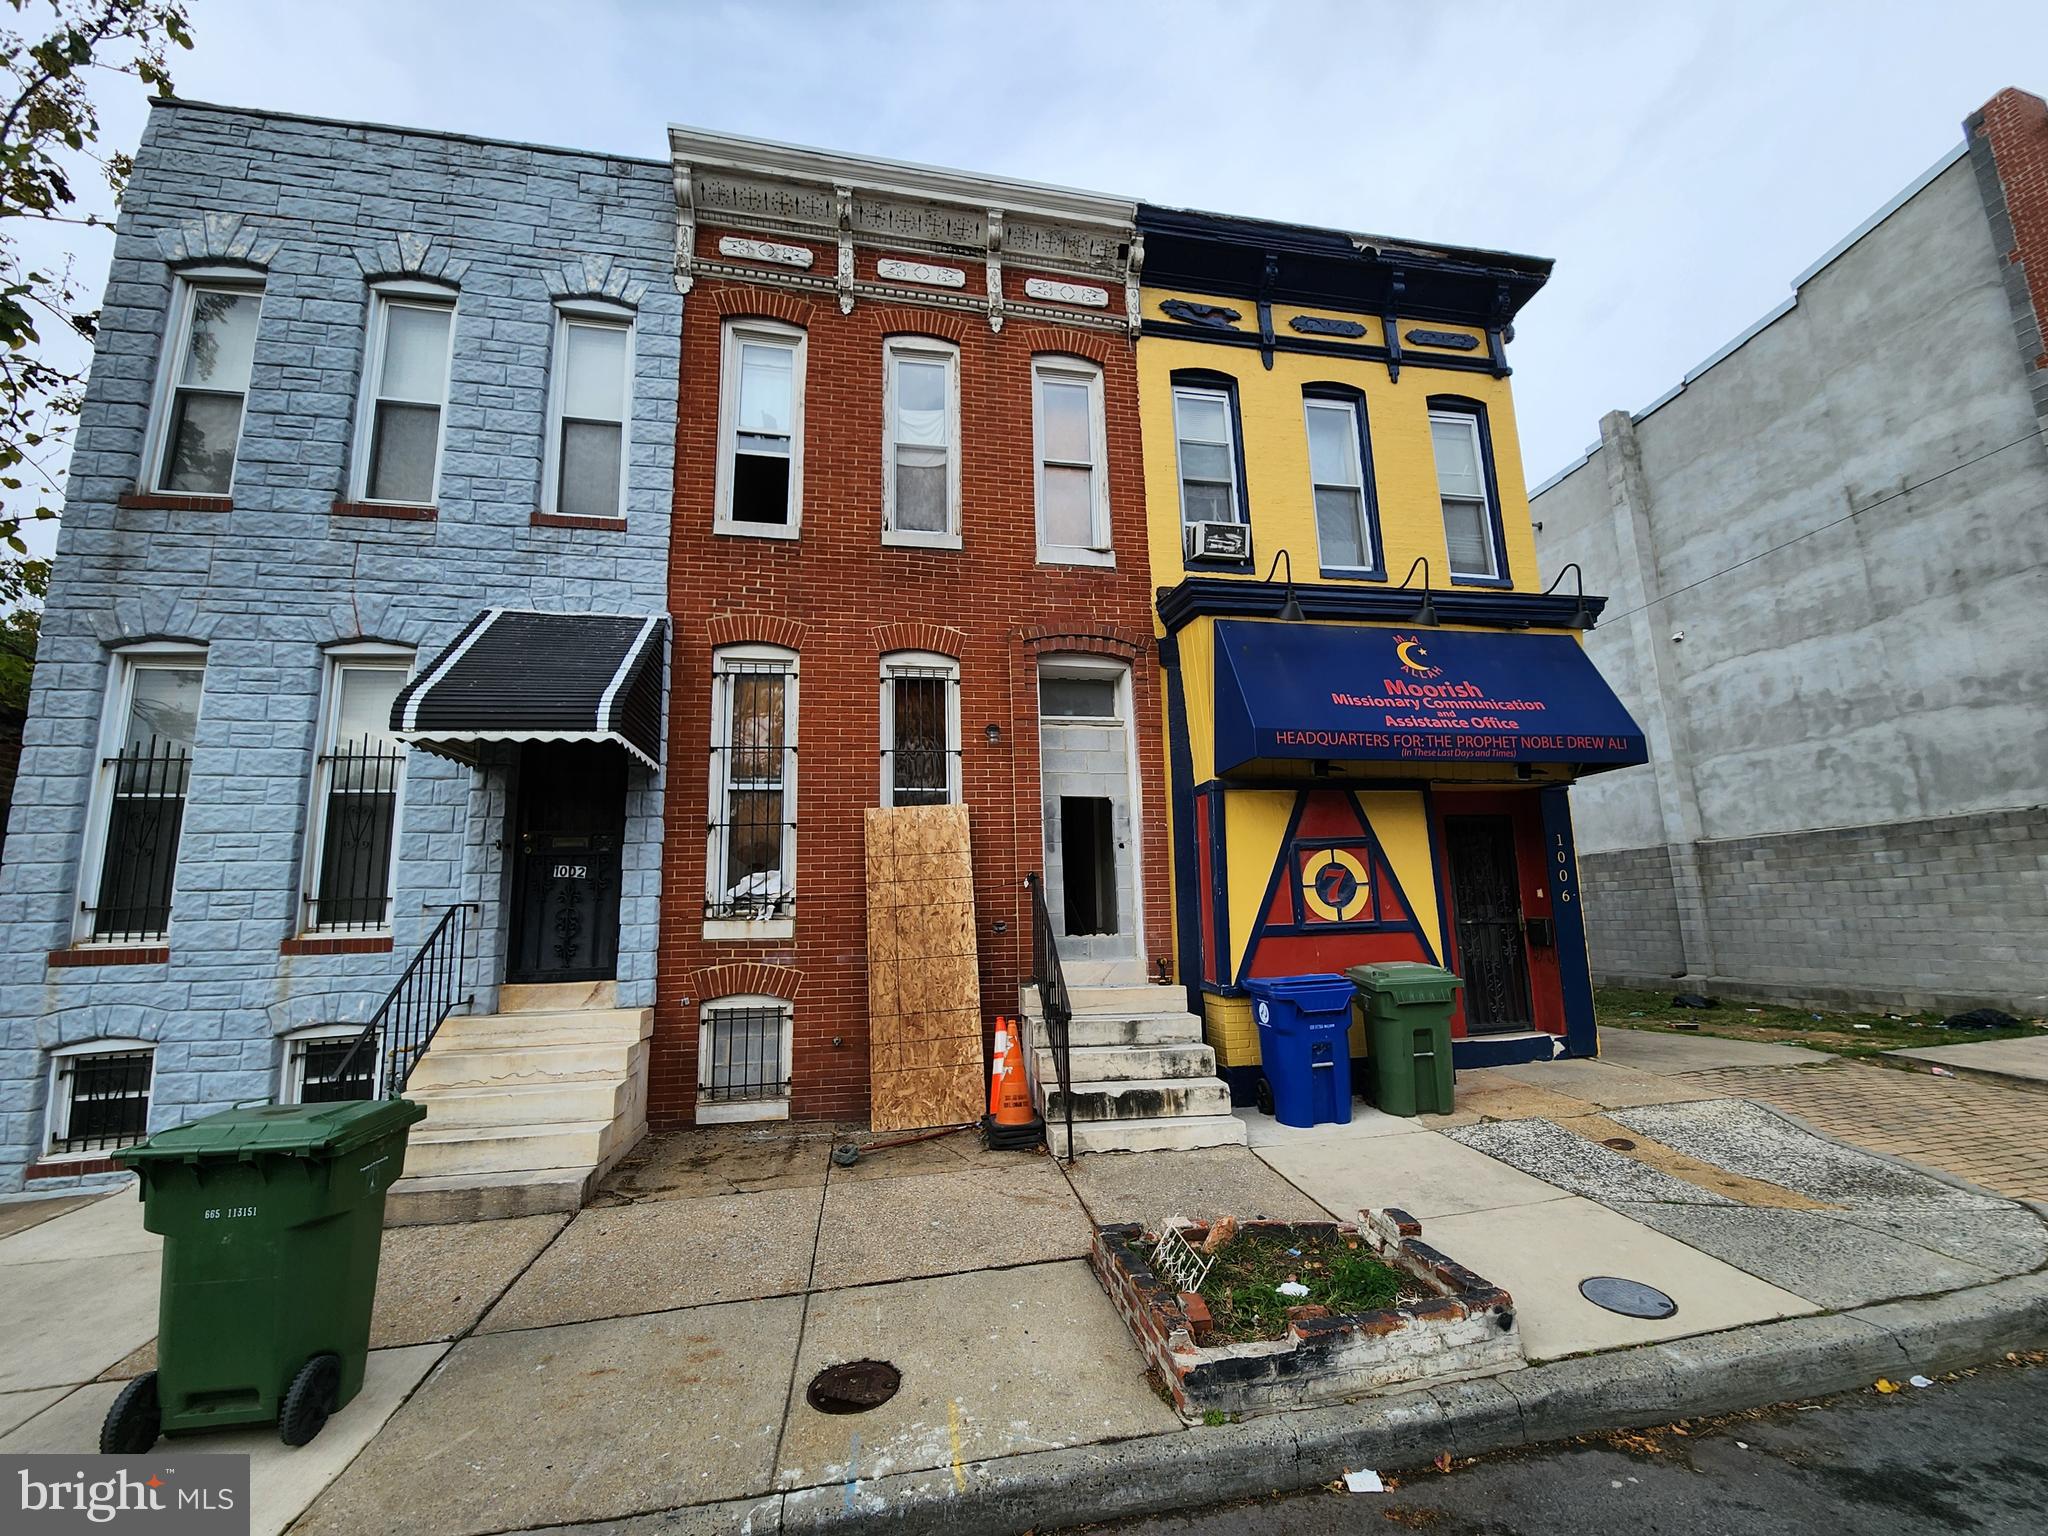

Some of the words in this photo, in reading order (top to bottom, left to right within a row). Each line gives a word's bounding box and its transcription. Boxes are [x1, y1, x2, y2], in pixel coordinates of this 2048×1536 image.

[1401, 664, 1444, 680] ALLAH
[1383, 679, 1484, 698] Moorish
[1331, 693, 1420, 710] Missionary
[1423, 697, 1546, 711] Communication
[1437, 710, 1457, 718] and
[1385, 715, 1470, 729] Assistance
[1471, 716, 1520, 730] Office
[1276, 731, 1390, 747] HEADQUARTERS
[1427, 735, 1453, 748] THE
[1457, 735, 1518, 749] PROPHET
[1520, 736, 1566, 749] NOBLE
[1567, 736, 1604, 749] DREW
[1608, 737, 1628, 750] ALI
[1401, 749, 1412, 758] (In
[1413, 749, 1437, 757] These
[1437, 749, 1454, 757] Last
[1454, 749, 1475, 759] Days
[1489, 749, 1517, 759] Times)
[554, 865, 586, 878] 1002
[1556, 834, 1571, 902] 1006
[204, 1209, 221, 1219] 665
[227, 1206, 257, 1218] 113151
